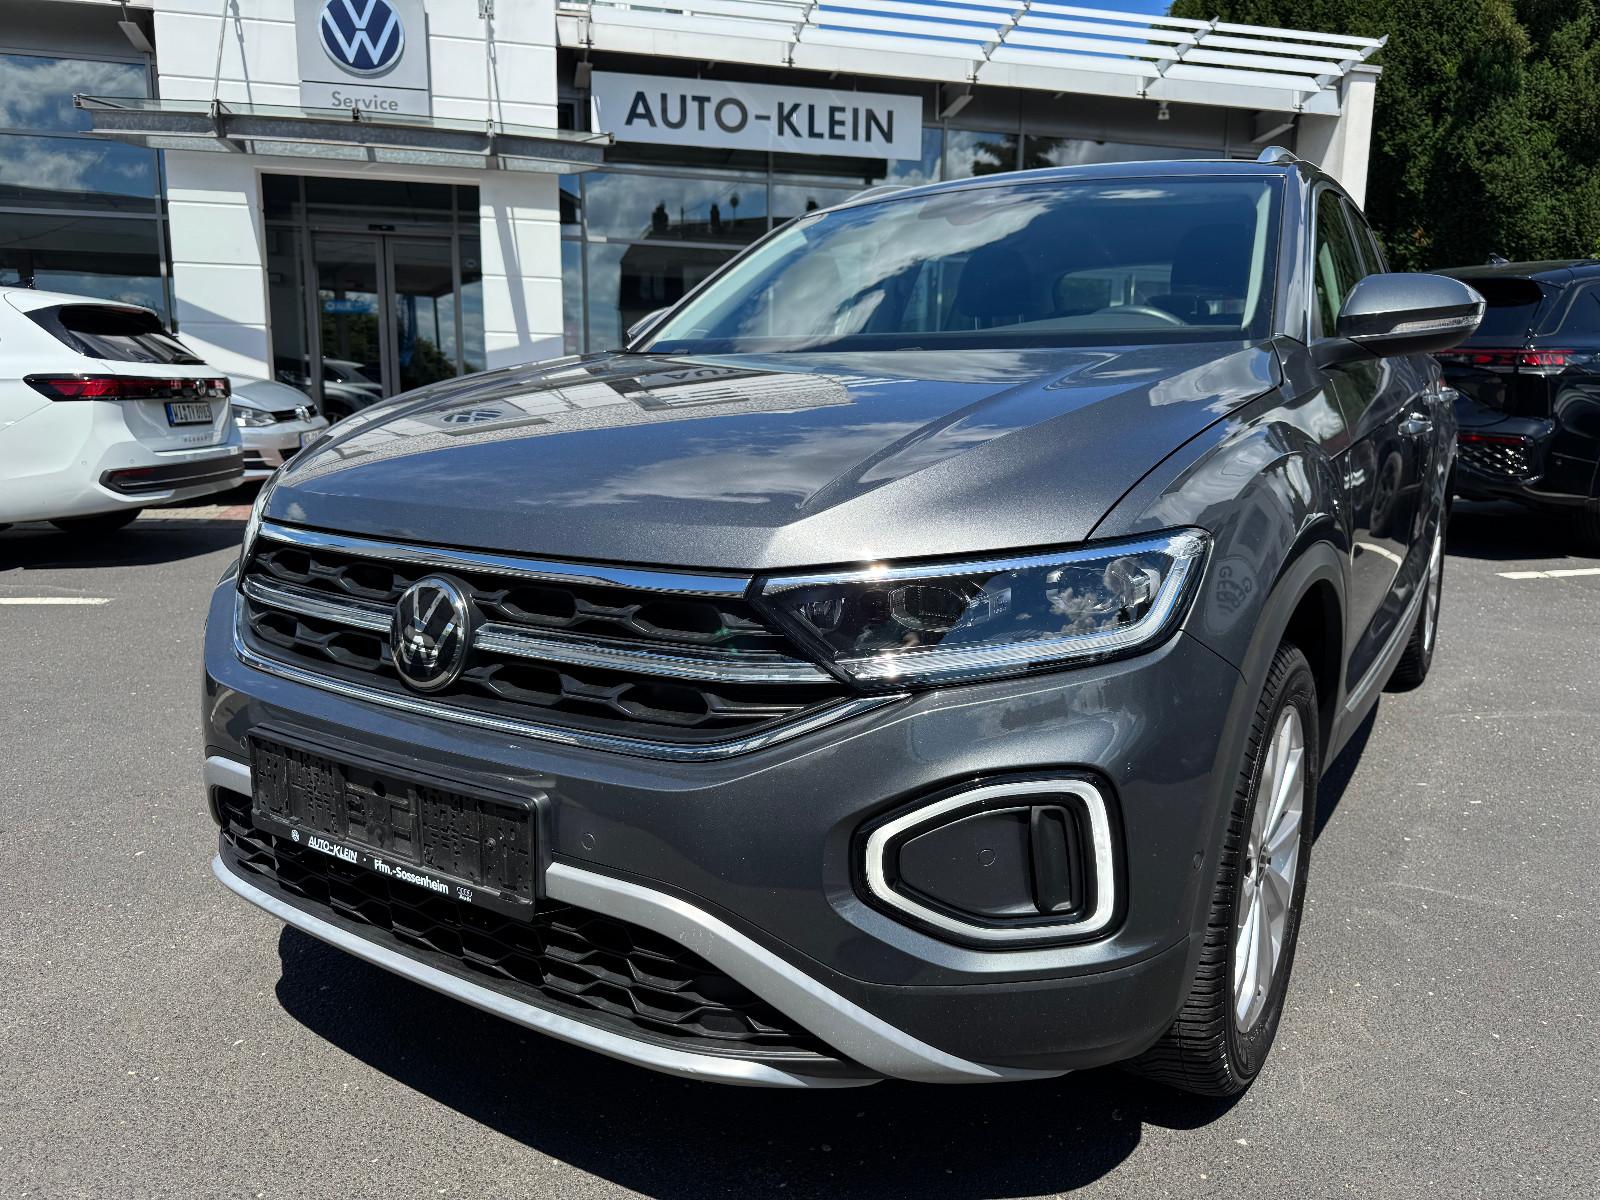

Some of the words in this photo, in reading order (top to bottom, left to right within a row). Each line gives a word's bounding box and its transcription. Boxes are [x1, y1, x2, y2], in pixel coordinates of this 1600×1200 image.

[331, 90, 399, 111] Service
[624, 90, 894, 144] AUTO-KLEIN
[307, 835, 358, 863] AUTO-KLEIN
